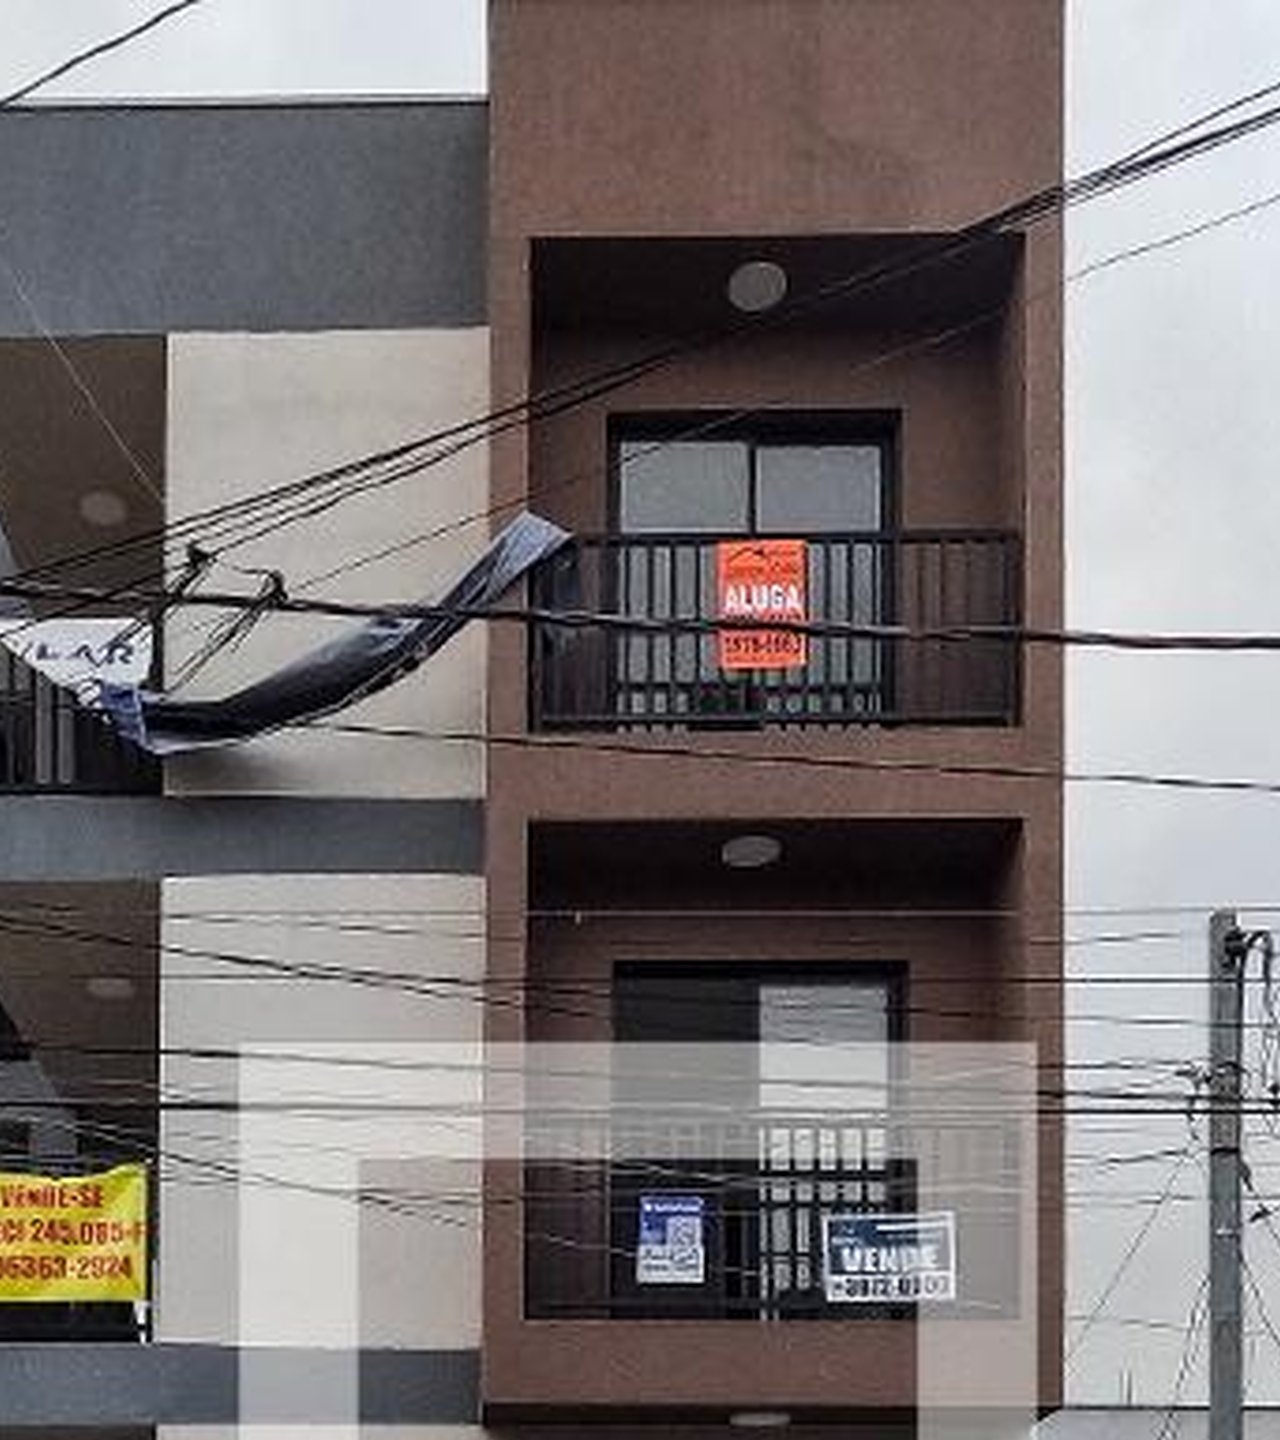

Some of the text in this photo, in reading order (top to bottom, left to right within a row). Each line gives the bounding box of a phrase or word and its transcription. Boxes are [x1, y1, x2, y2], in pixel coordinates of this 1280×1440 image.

[725, 583, 804, 613] ALUGA
[1, 1184, 104, 1208] VENDE-SE
[842, 1246, 938, 1272] VENDE
